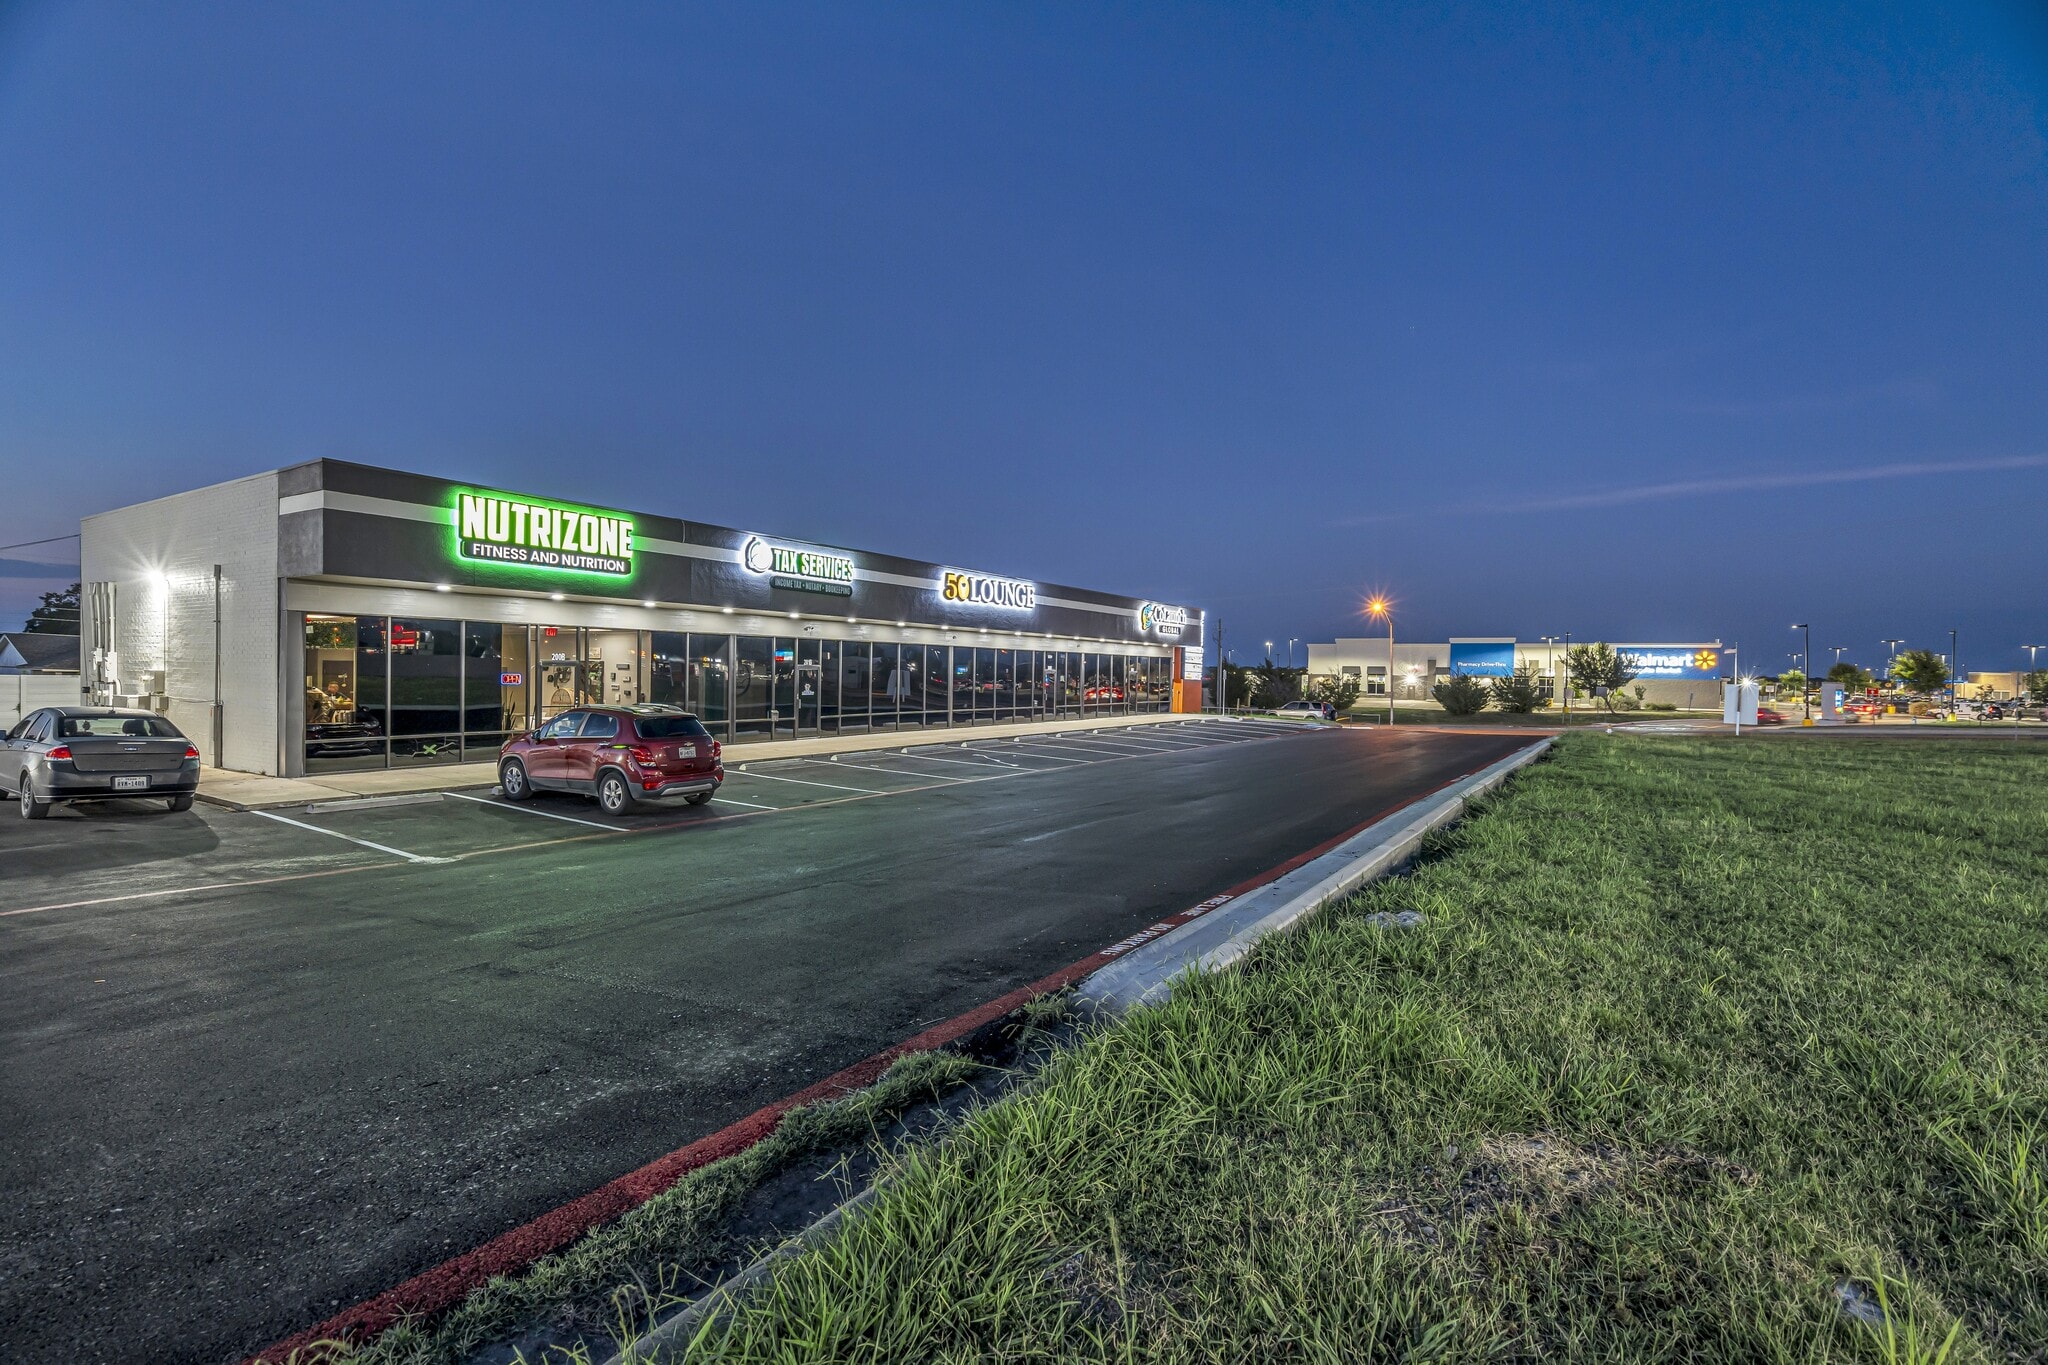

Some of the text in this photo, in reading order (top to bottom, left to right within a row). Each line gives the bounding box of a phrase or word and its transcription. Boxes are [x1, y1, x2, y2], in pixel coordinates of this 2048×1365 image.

[462, 495, 633, 558] NUTRIZONE
[473, 543, 625, 572] FITNESS AND NUTRITION
[774, 549, 854, 581] TAX SERVICES
[969, 577, 1035, 608] LOUNGE
[1161, 625, 1180, 635] GLOBAL
[1620, 653, 1693, 667] Walmart
[501, 674, 520, 684] OPEN
